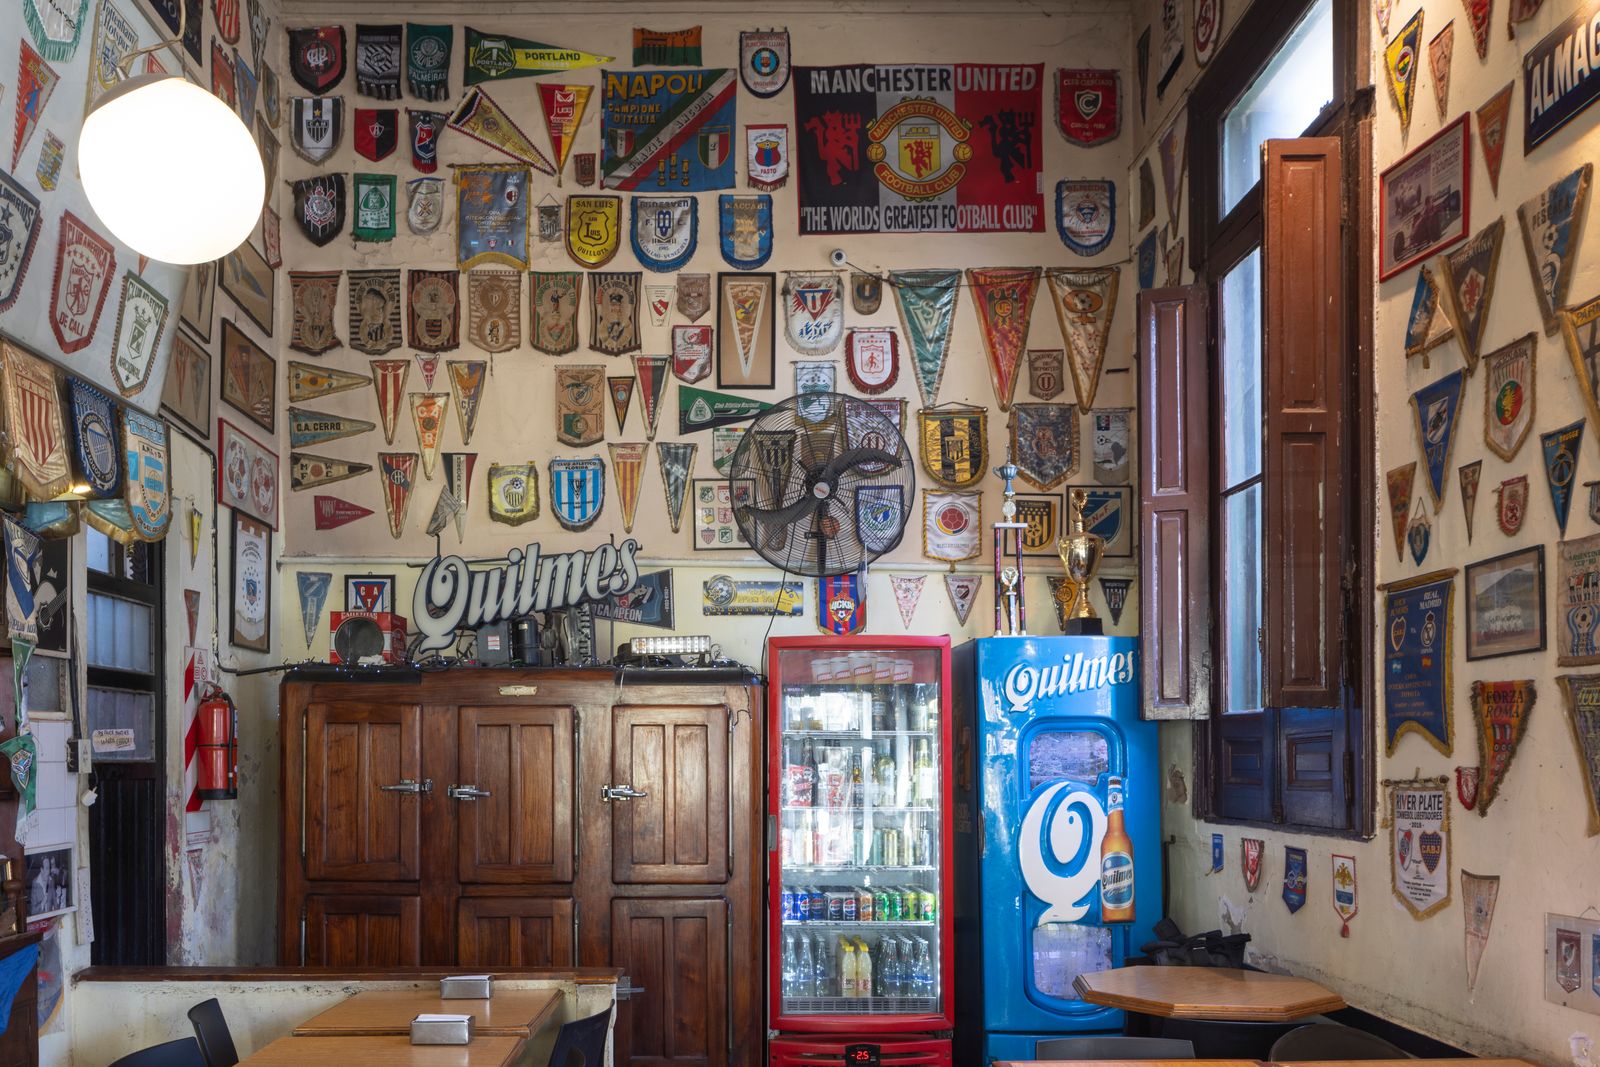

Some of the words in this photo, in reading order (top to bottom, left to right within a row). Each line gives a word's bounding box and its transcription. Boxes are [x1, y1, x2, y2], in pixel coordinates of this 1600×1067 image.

[102, 0, 136, 44] Tottenham
[103, 15, 131, 53] Hotspur
[524, 52, 581, 63] PORTLAND
[607, 73, 703, 101] NAPOLI
[809, 68, 952, 94] MANCHESTER
[956, 67, 1037, 92] UNITED
[608, 103, 661, 114] CAMPIONE
[873, 102, 935, 138] MANCHESTER
[935, 106, 965, 139] UNITED
[759, 167, 777, 176] PASTO
[879, 169, 933, 194] FOOTBALL
[934, 170, 961, 193] CLUB
[575, 201, 592, 210] SAN
[594, 201, 614, 210] LUIS
[828, 205, 880, 231] WORLDS
[884, 204, 940, 230] GREATEST
[942, 204, 1001, 230] FOOTBALL
[576, 246, 610, 259] QUILLOTA
[68, 316, 85, 337] CALI
[417, 406, 427, 417] C
[430, 405, 441, 416] A
[313, 421, 341, 432] CERRO
[424, 433, 433, 444] R
[412, 538, 639, 655] Quilmes
[1423, 590, 1440, 600] REAL
[1419, 598, 1442, 610] MADRID
[1005, 650, 1135, 712] Quilmes
[1485, 689, 1524, 705] FORZA
[1484, 704, 1521, 719] ROMA
[1396, 794, 1417, 811] RIVER
[1418, 794, 1443, 811] PLATE
[1018, 780, 1108, 927] Q
[1421, 845, 1441, 853] CABJ
[1102, 869, 1133, 890] Quilmes
